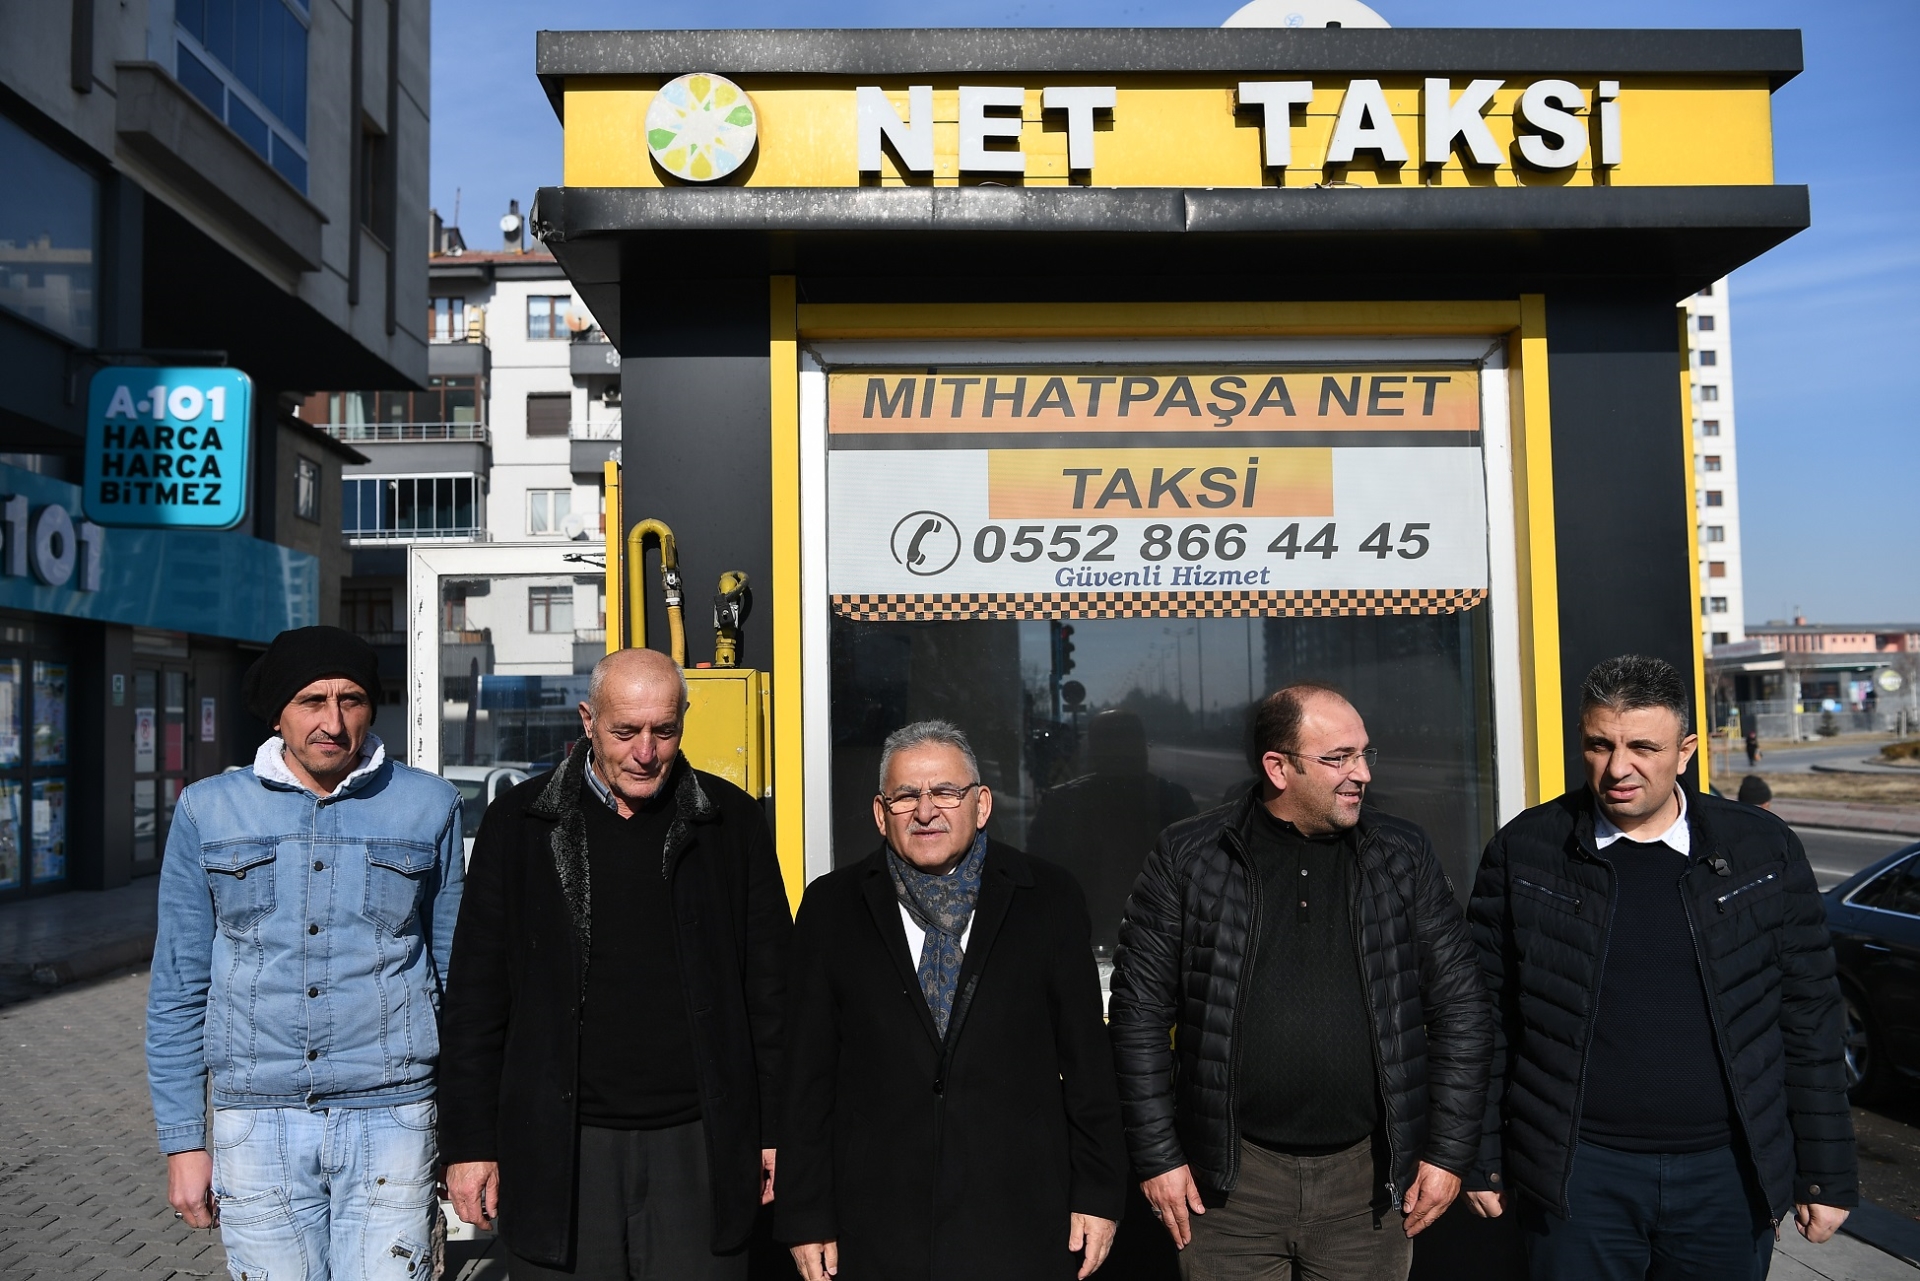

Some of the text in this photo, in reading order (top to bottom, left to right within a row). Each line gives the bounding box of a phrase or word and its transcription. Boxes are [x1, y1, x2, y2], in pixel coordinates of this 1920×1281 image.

[856, 85, 1117, 172] NET
[862, 367, 1452, 427] MİTHATPAŞA NET
[104, 426, 222, 450] HARCA
[103, 454, 221, 478] HARCA
[1062, 456, 1259, 510] TAKSİ
[973, 522, 1431, 564] 0552 866 44 45
[1055, 565, 1271, 590] Güvenli Hizmet
